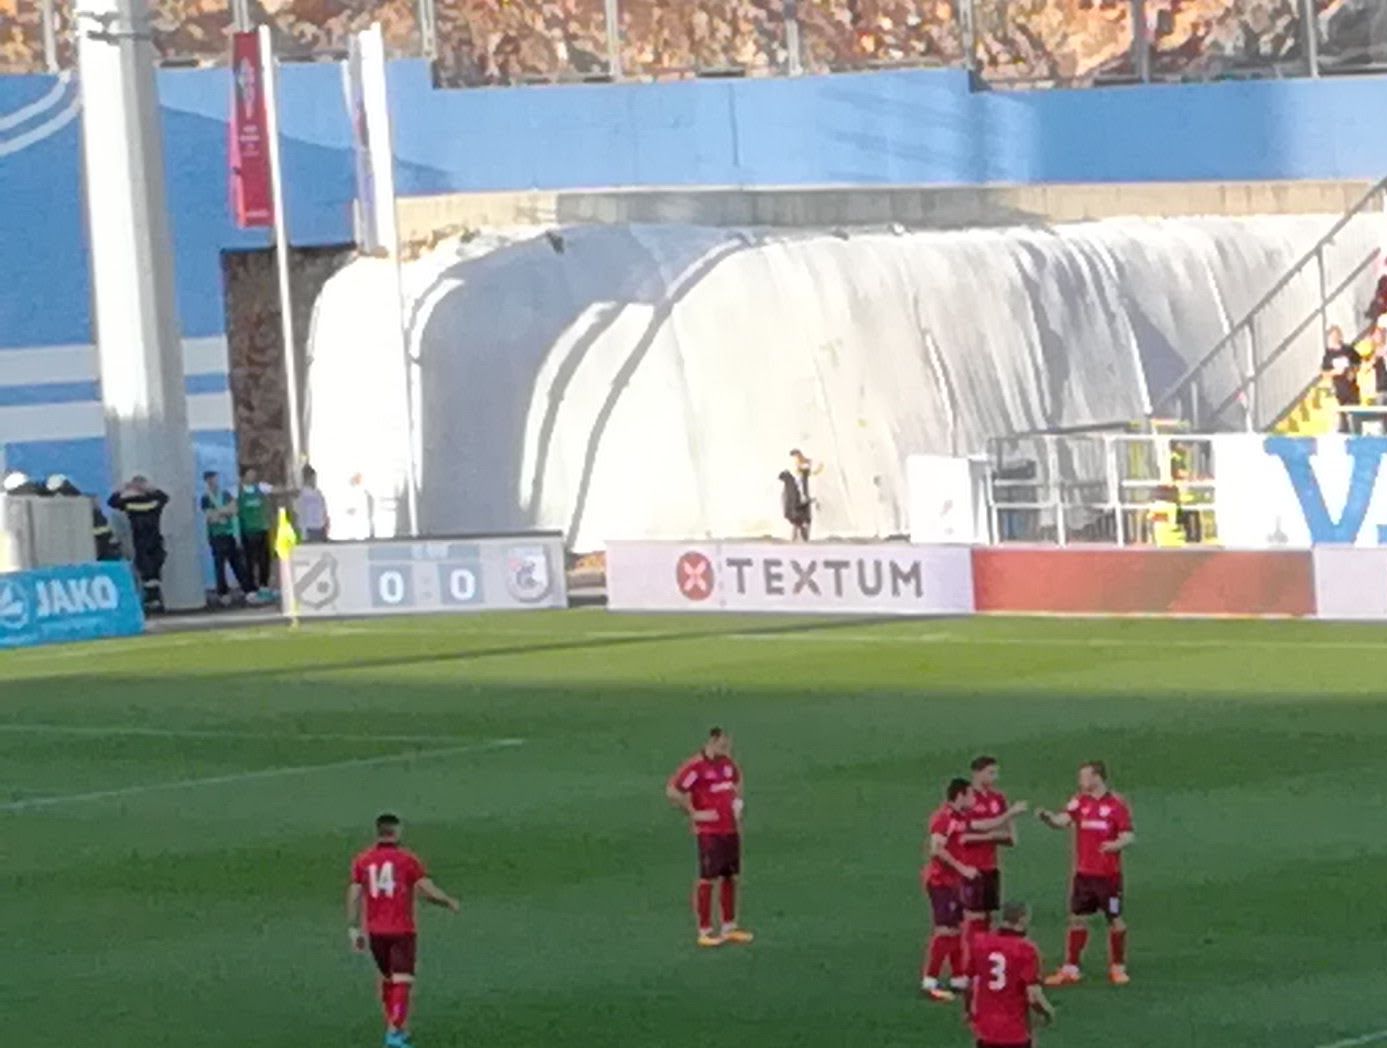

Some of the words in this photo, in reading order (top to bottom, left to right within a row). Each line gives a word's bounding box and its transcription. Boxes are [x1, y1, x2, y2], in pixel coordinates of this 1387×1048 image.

[35, 575, 119, 617] JAKO
[379, 571, 404, 603] 0
[450, 568, 475, 601] 0
[726, 557, 923, 598] TEXTUM
[368, 861, 395, 898] 14
[988, 952, 1006, 990] 3
